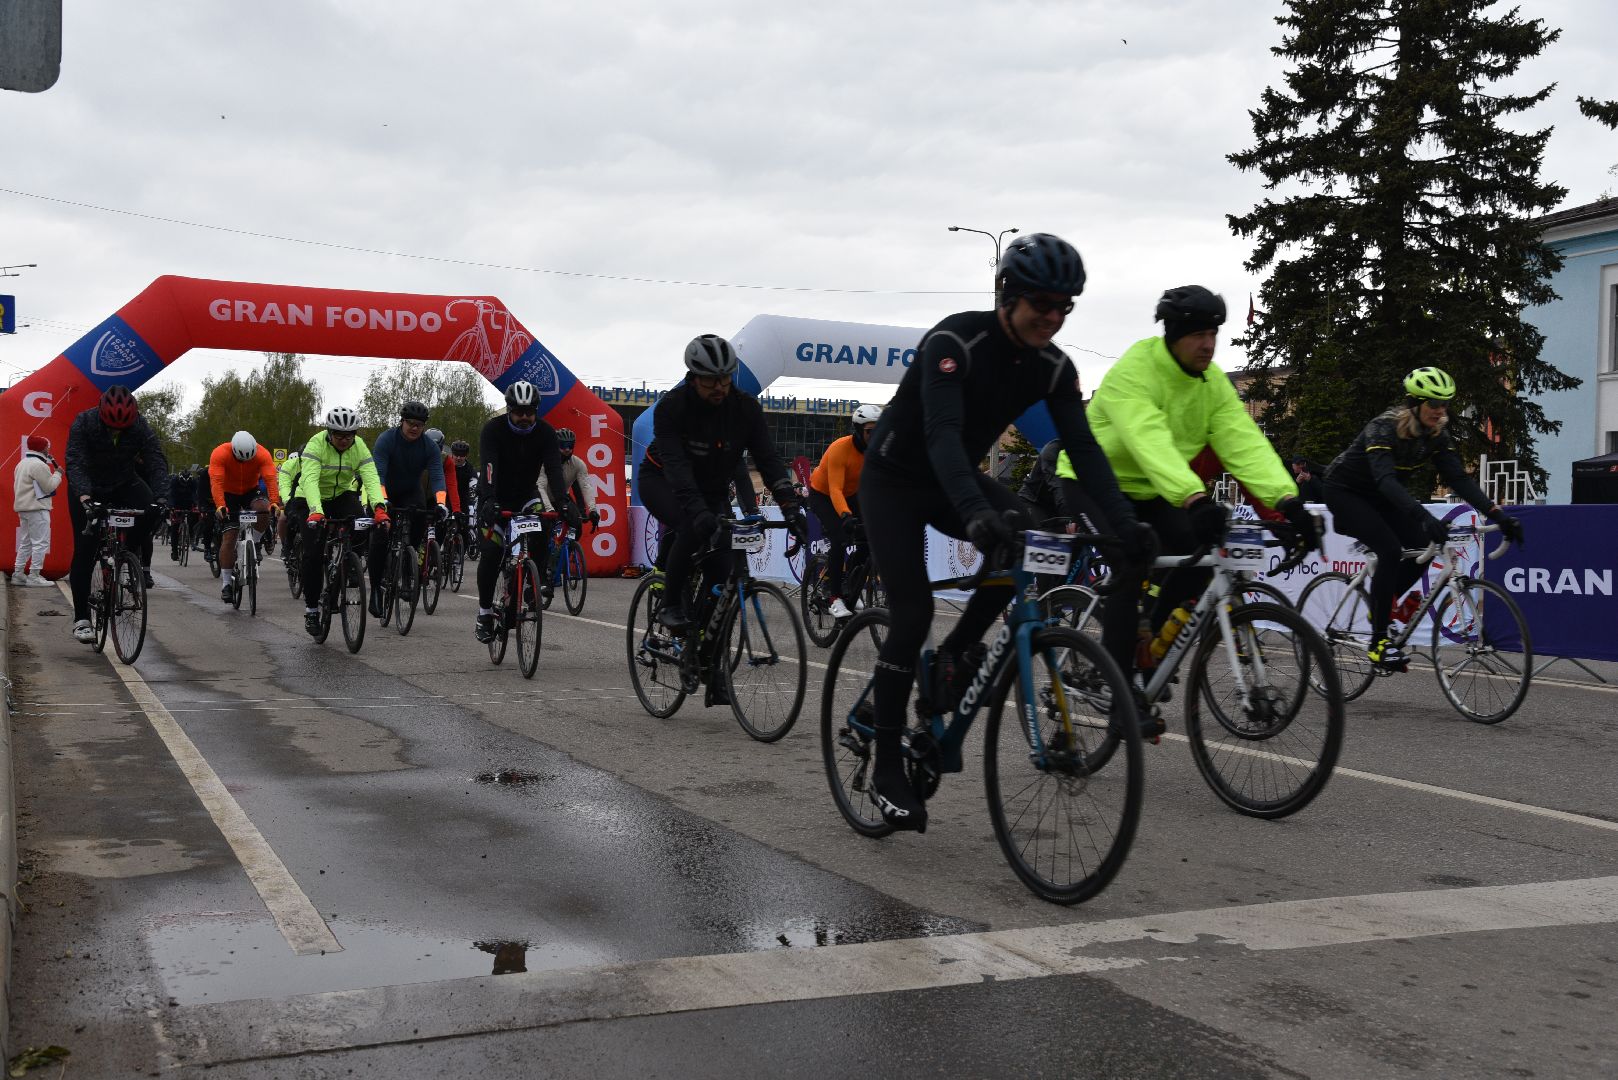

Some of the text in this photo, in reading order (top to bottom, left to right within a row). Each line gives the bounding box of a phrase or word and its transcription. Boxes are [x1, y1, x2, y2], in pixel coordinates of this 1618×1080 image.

[208, 298, 443, 333] GRAN FONDO
[796, 342, 878, 367] GRAN
[806, 397, 861, 414] ЦЕНТР
[586, 414, 618, 557] FONDO
[1028, 551, 1068, 566] 1009
[1503, 567, 1614, 596] GRAN
[959, 624, 1012, 716] COLNAGO
